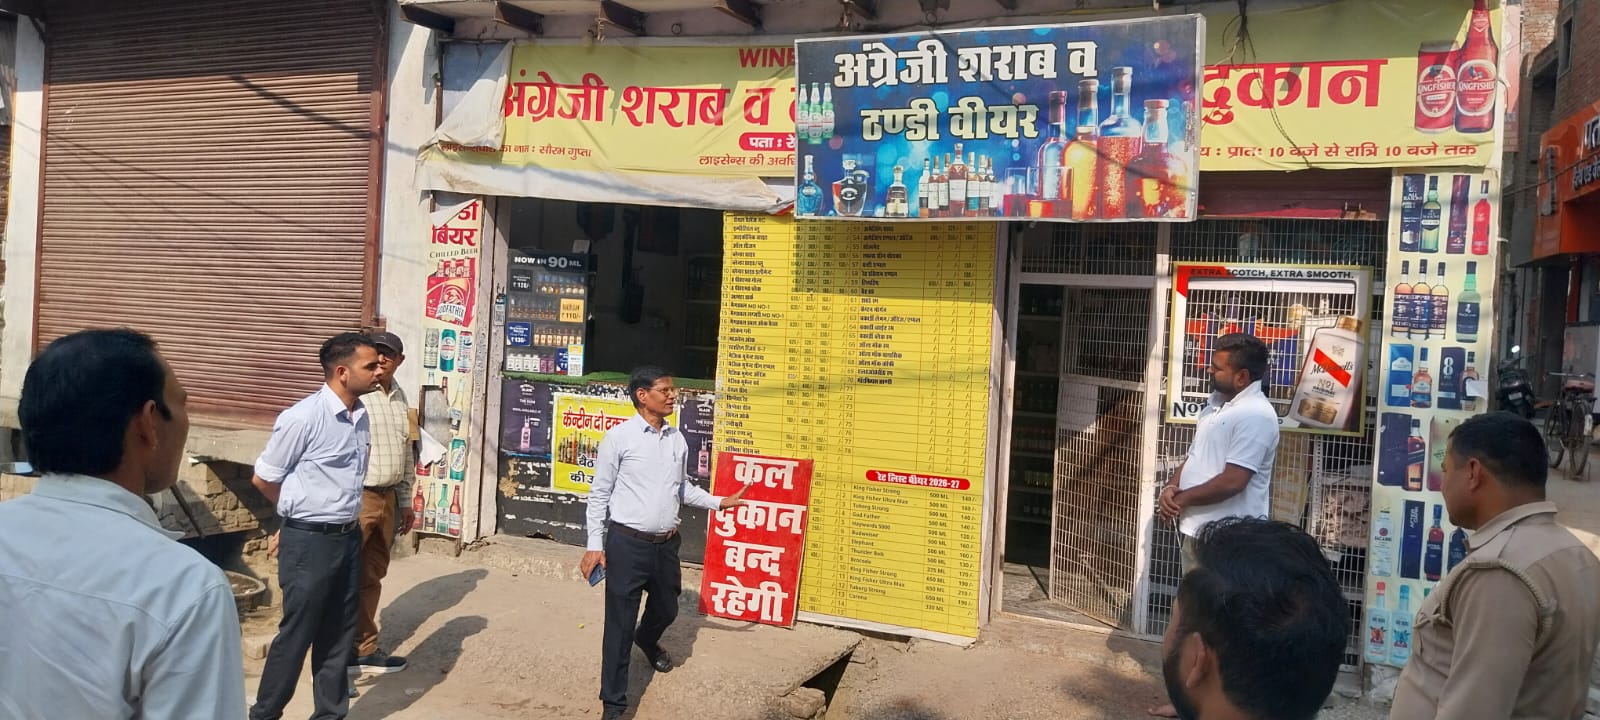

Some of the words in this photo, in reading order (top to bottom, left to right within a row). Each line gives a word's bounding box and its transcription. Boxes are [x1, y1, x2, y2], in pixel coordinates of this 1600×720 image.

[834, 40, 948, 88] अंग्रेजी
[958, 41, 1058, 82] शराब
[1067, 41, 1098, 78] व
[504, 69, 608, 122] अंग्रेजी
[621, 86, 730, 128] शराब
[744, 87, 775, 126] व
[1201, 58, 1388, 126] दुकान
[860, 97, 940, 142] ठण्डी
[568, 146, 590, 160] गुप्ता
[749, 137, 774, 148] पता
[1269, 146, 1284, 158] 10
[1324, 141, 1341, 156] से
[1345, 141, 1378, 158] रात्रि
[1386, 145, 1401, 156] 10
[1406, 141, 1438, 156] बजे
[1444, 144, 1478, 156] तक
[700, 154, 746, 166] लाइसेन्स
[750, 154, 764, 166] की
[548, 256, 568, 268] 90
[1226, 268, 1268, 278] SCOTCH,
[1270, 270, 1304, 278] EXTRA
[1307, 270, 1354, 278] SMOOTH.
[570, 470, 585, 482] की
[733, 456, 799, 490] कल
[876, 471, 886, 481] रेट
[929, 477, 960, 488] 2026-27
[715, 498, 808, 537] दुकान
[723, 540, 785, 577] बन्द
[710, 576, 789, 622] रहेगी
